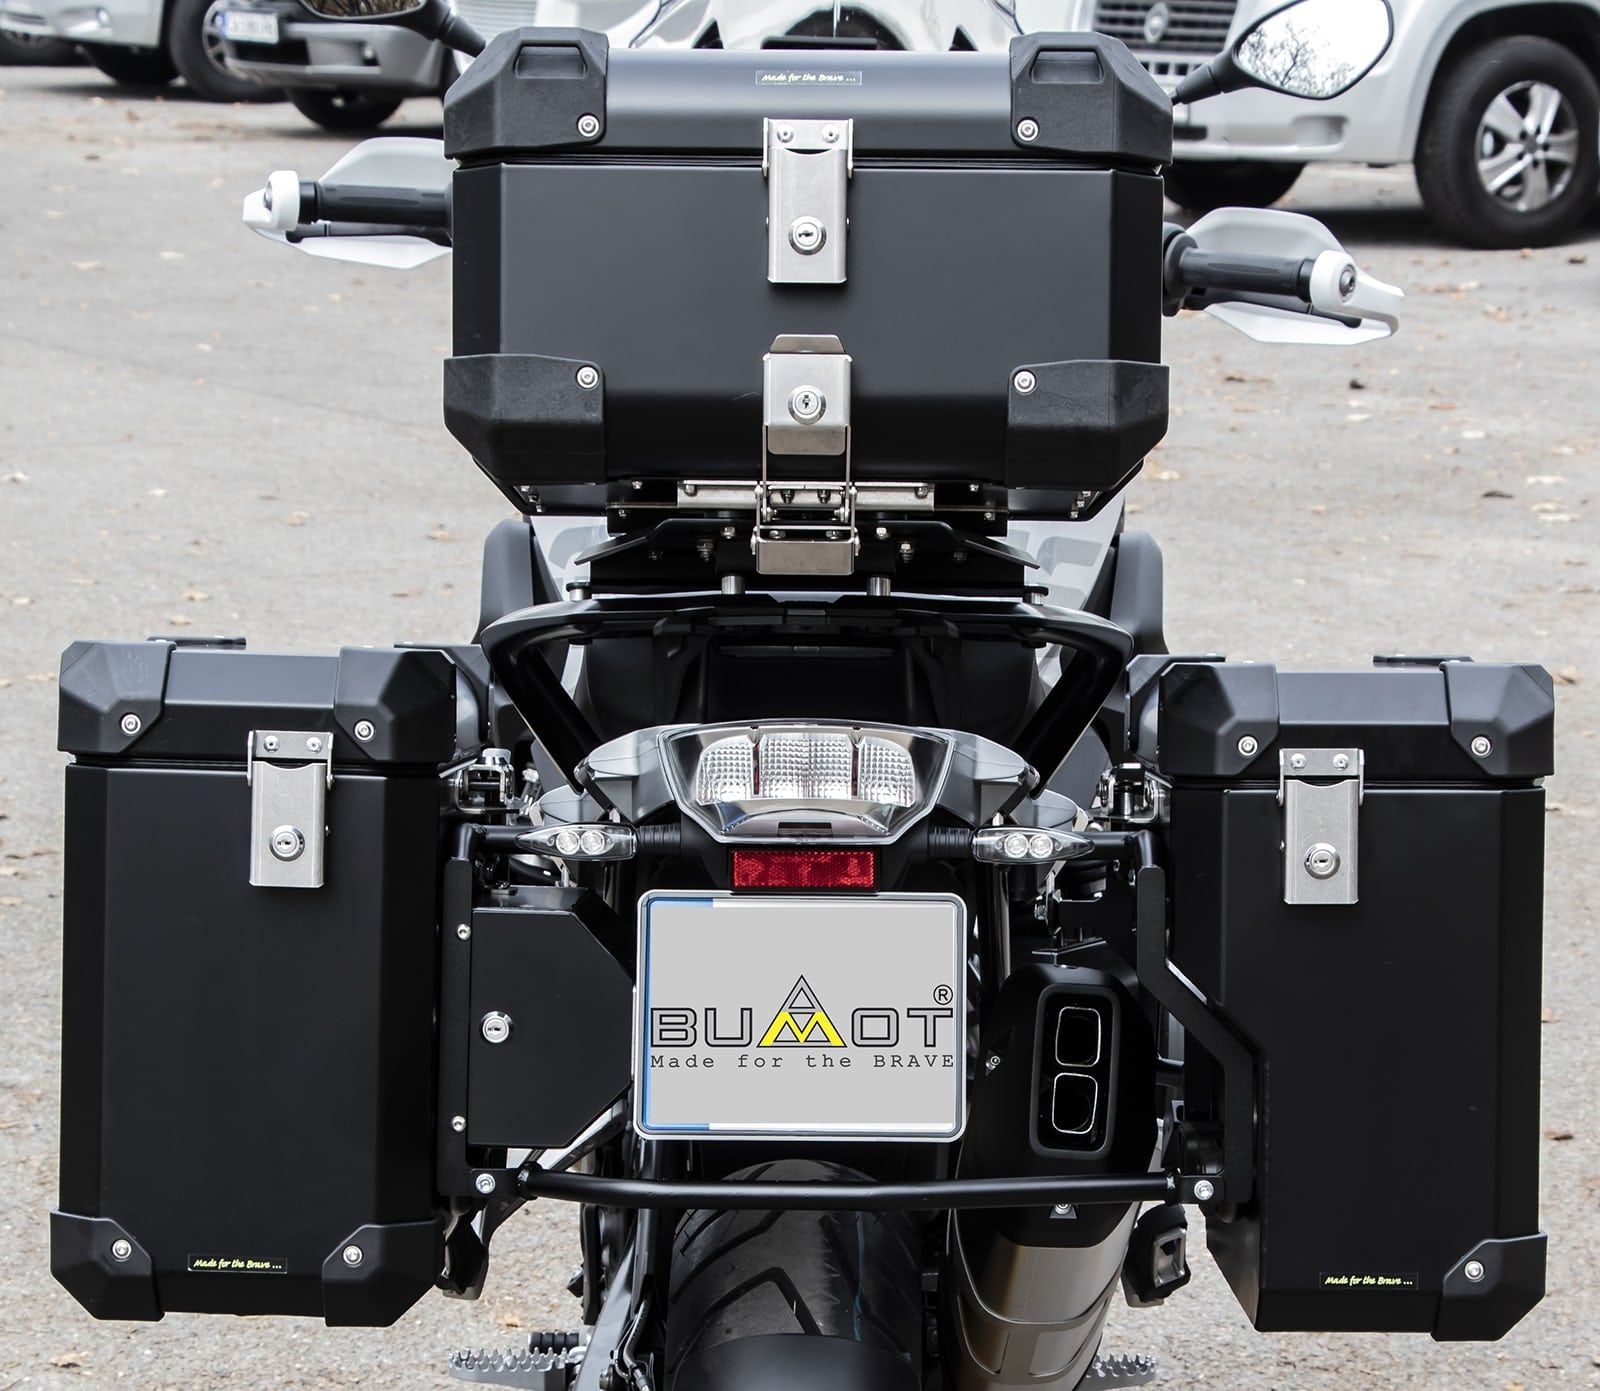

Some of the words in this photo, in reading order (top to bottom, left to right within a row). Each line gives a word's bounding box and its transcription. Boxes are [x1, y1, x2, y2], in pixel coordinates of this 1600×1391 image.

[761, 73, 787, 82] Made
[788, 73, 802, 83] for
[802, 73, 817, 82] the
[818, 73, 844, 82] Brave
[650, 1054, 716, 1069] Made
[737, 1054, 784, 1068] for
[806, 1054, 852, 1068] the
[873, 1054, 954, 1069] BRAVE
[193, 1258, 218, 1268] Made
[218, 1258, 232, 1270] for
[231, 1259, 245, 1268] the
[246, 1260, 271, 1269] Brave
[1324, 1275, 1349, 1285] Made
[1349, 1275, 1362, 1286] for
[1362, 1275, 1376, 1285] the
[1377, 1276, 1402, 1285] Brave
